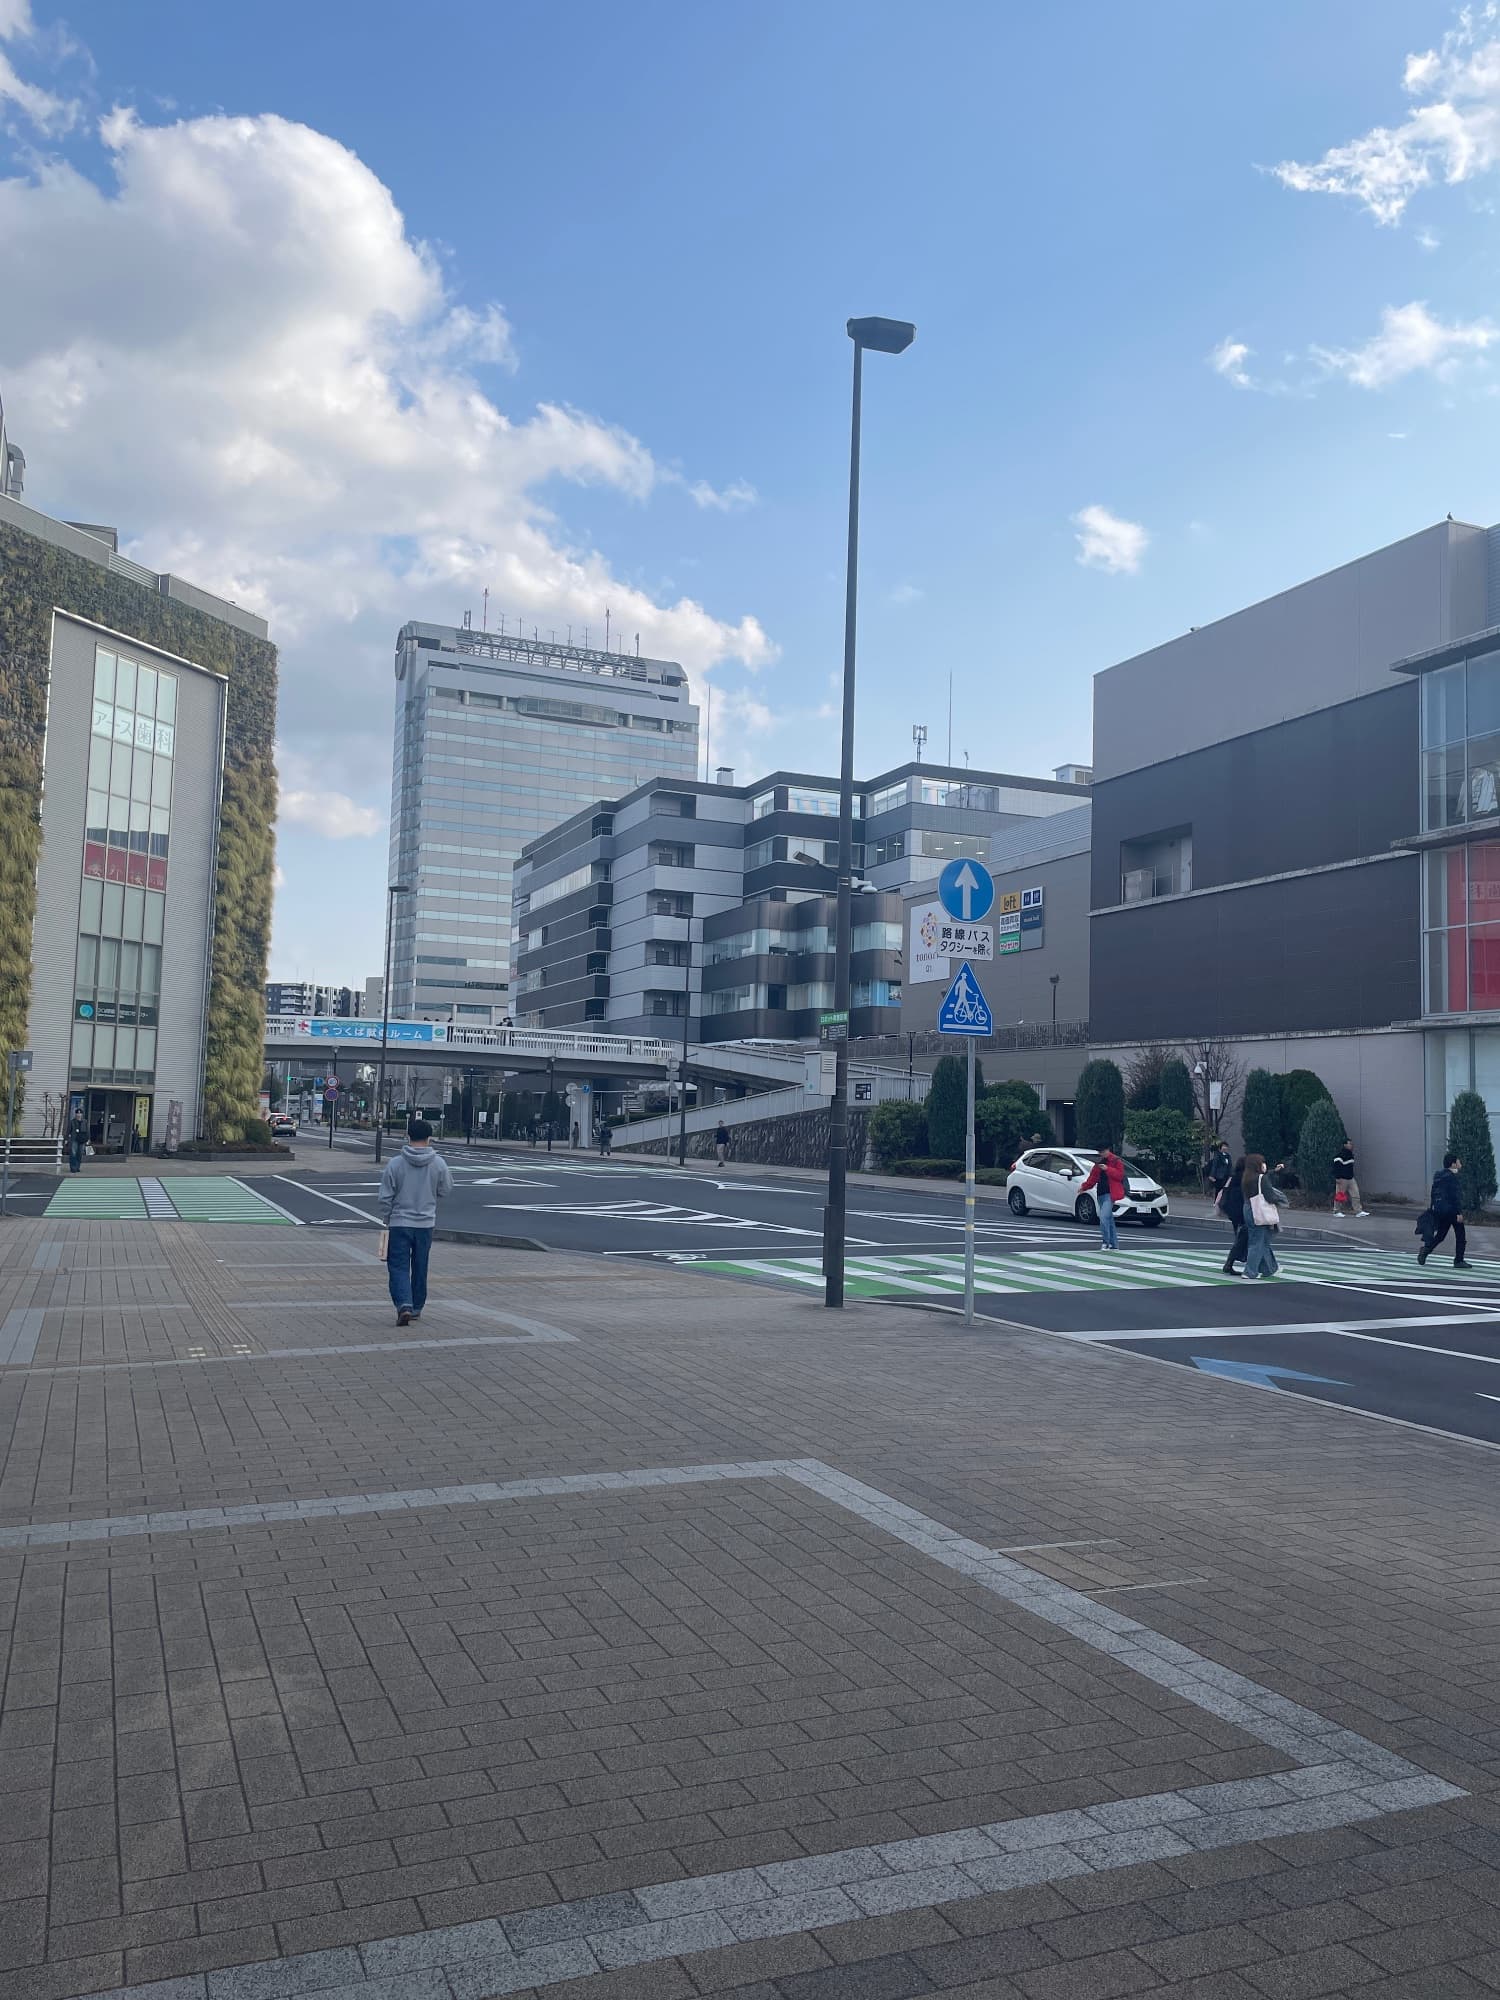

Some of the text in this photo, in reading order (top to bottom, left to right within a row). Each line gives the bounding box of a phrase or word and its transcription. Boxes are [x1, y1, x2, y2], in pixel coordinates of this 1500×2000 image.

[94, 710, 172, 752] アース歯科
[942, 928, 990, 942] 路線バス
[940, 941, 991, 955] タクシーを除く
